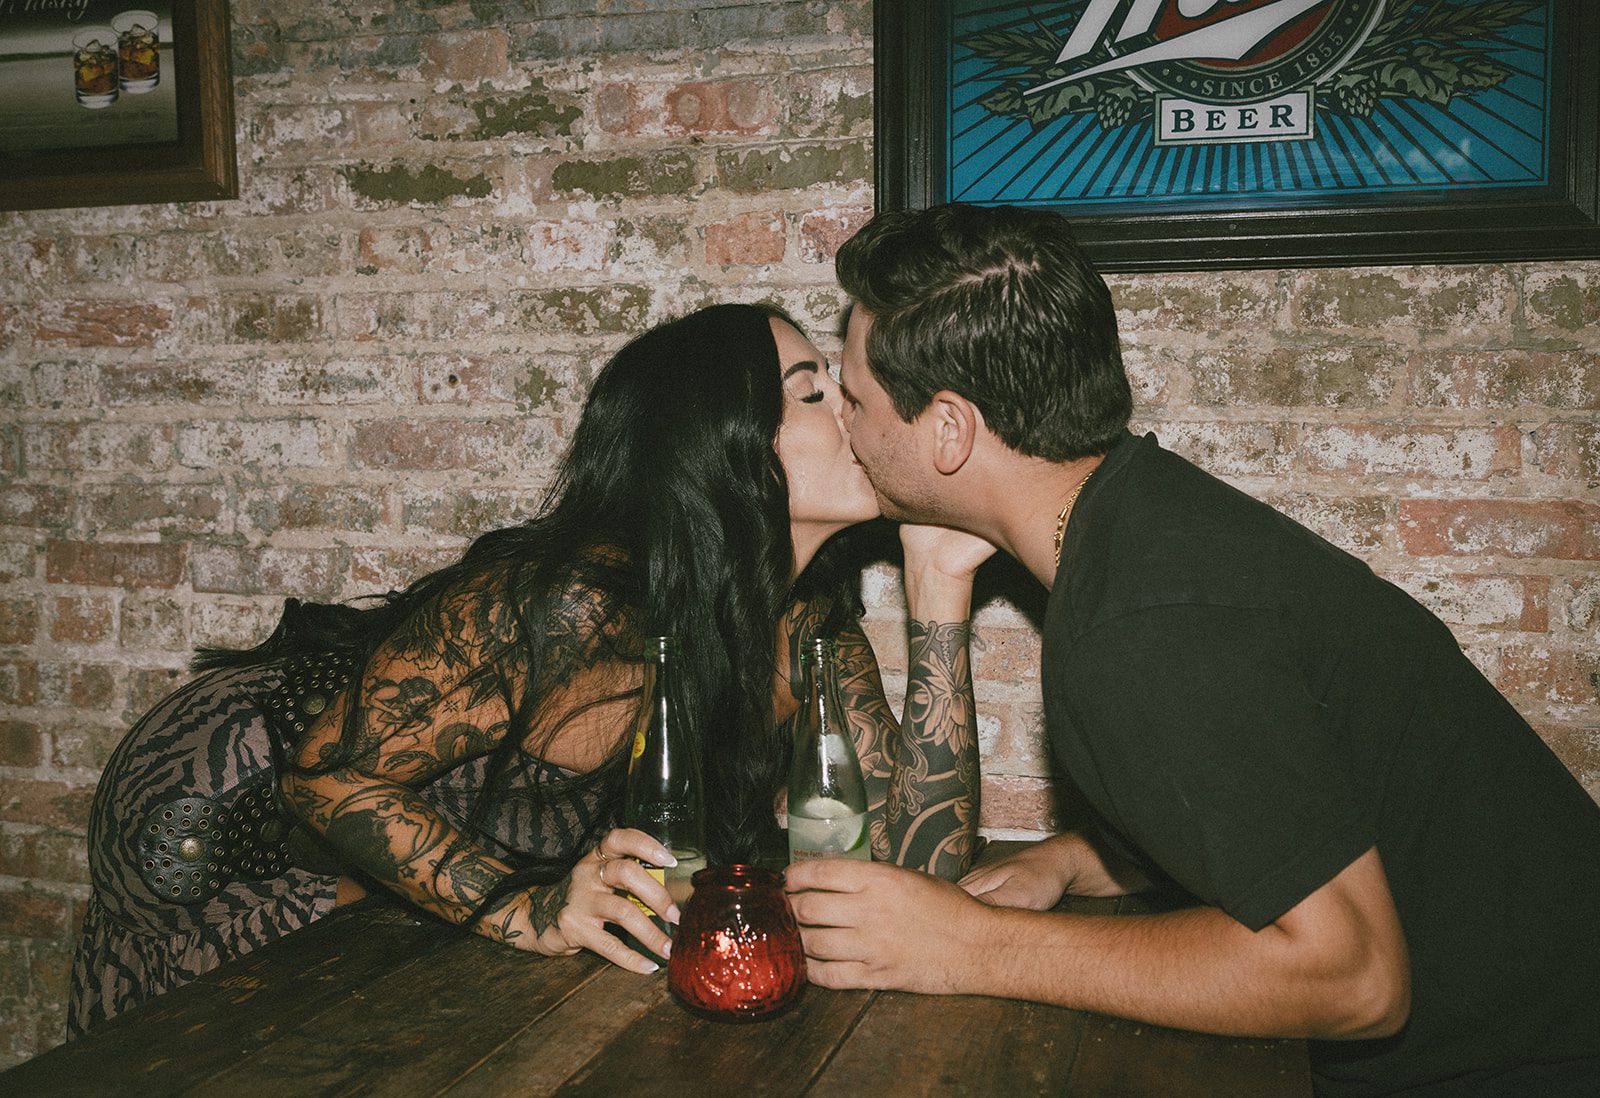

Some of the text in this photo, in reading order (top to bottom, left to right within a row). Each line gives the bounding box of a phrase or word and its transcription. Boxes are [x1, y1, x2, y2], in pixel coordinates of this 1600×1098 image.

[1201, 72, 1283, 97] SINCE
[1294, 31, 1344, 76] 1855
[1171, 104, 1295, 133] BEER
